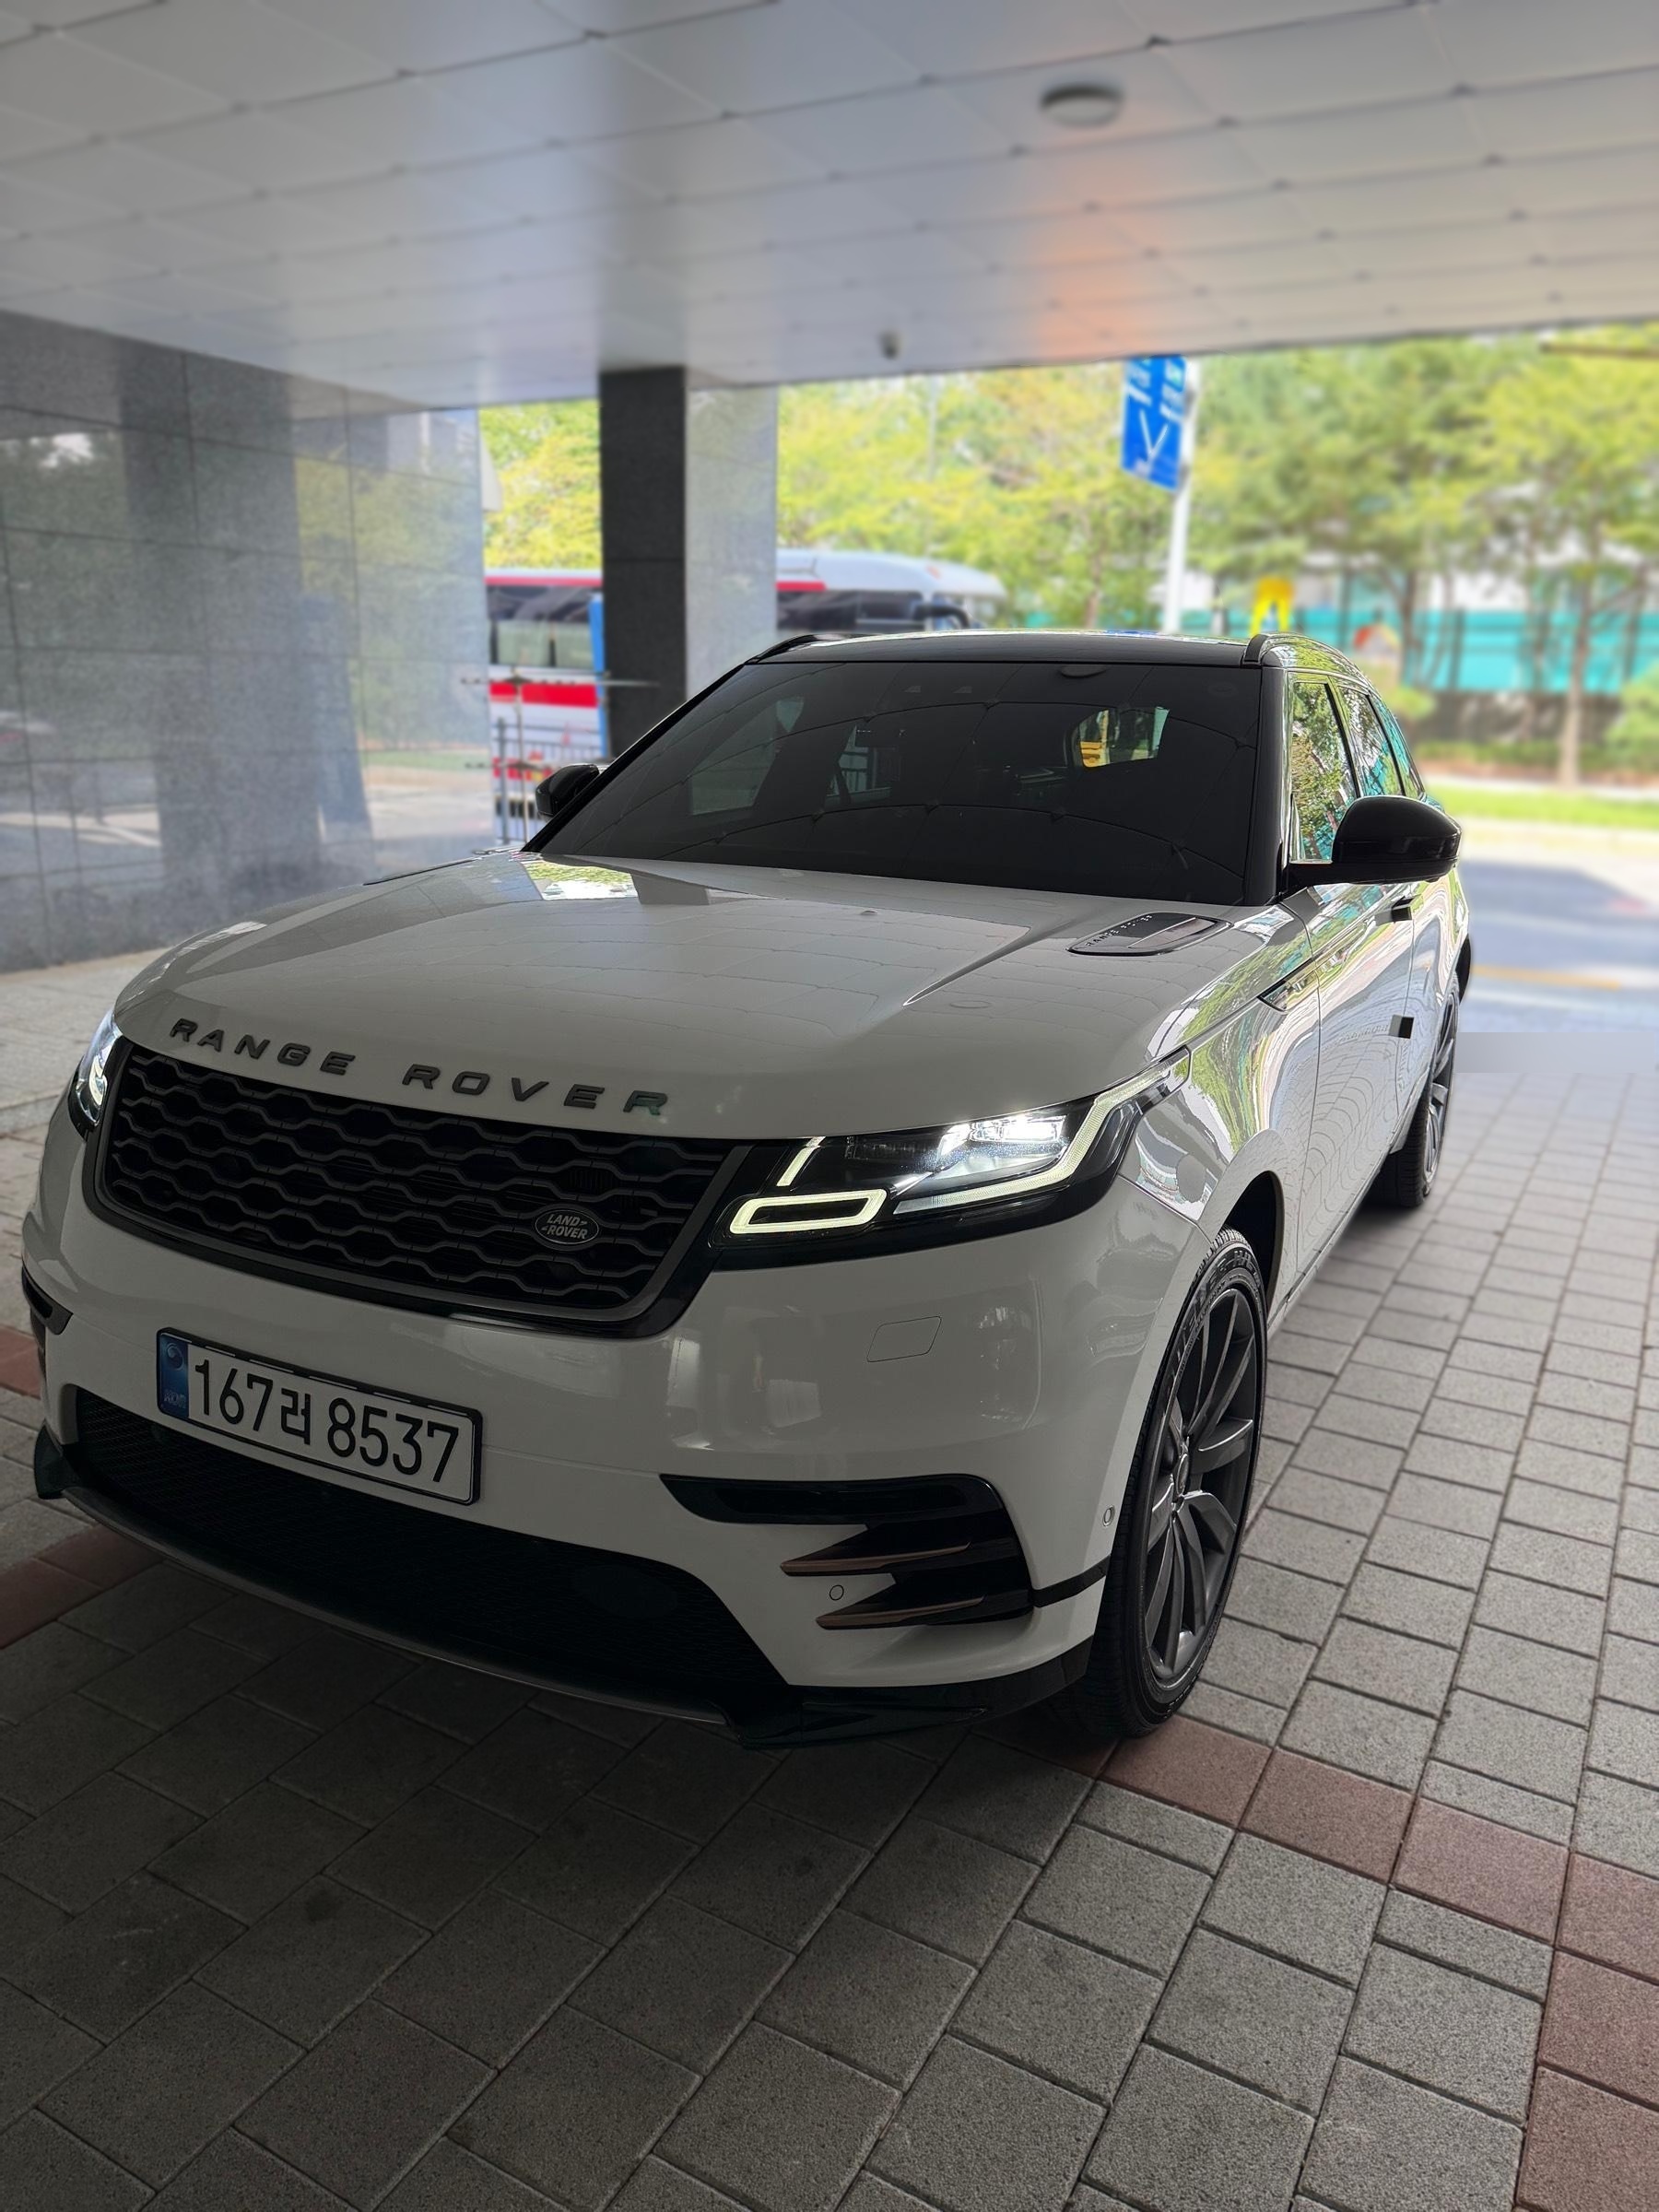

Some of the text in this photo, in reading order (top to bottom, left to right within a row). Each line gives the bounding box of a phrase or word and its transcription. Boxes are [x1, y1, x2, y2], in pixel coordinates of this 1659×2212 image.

[169, 1018, 669, 1115] RANGE ROVER
[547, 1214, 581, 1227] LAND
[547, 1225, 588, 1240] ROVER
[194, 1359, 459, 1482] 167러 8537
